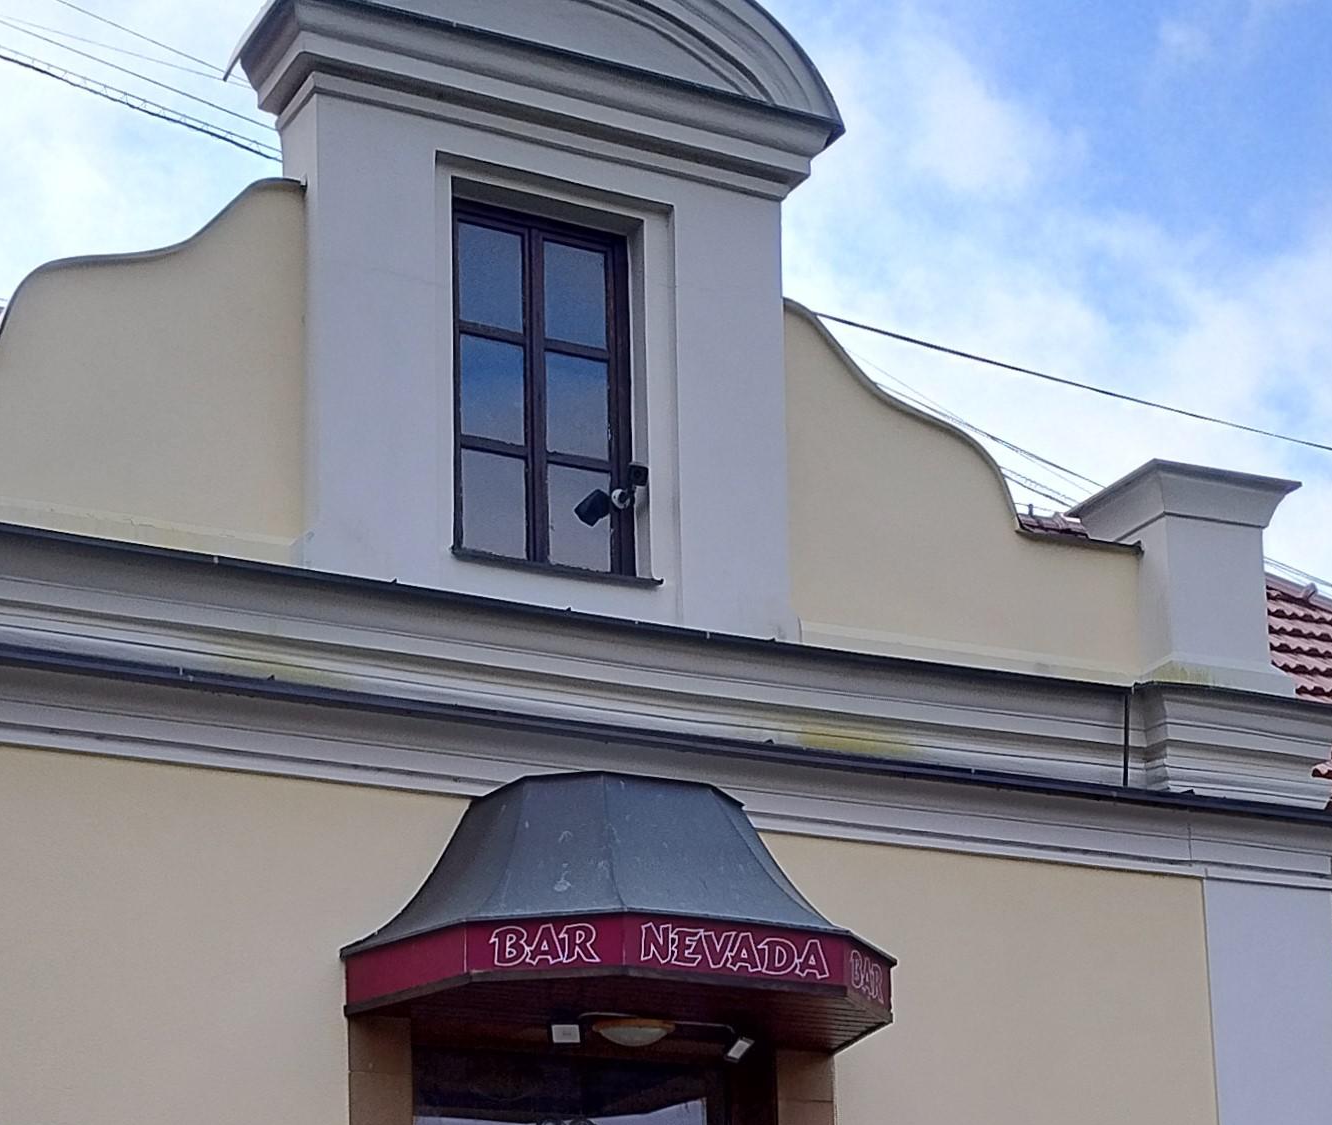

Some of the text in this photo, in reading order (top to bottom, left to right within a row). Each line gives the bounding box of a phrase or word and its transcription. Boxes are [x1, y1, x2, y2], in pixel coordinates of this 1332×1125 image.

[489, 921, 831, 980] BAR NEVADA
[850, 949, 885, 1005] BAR
